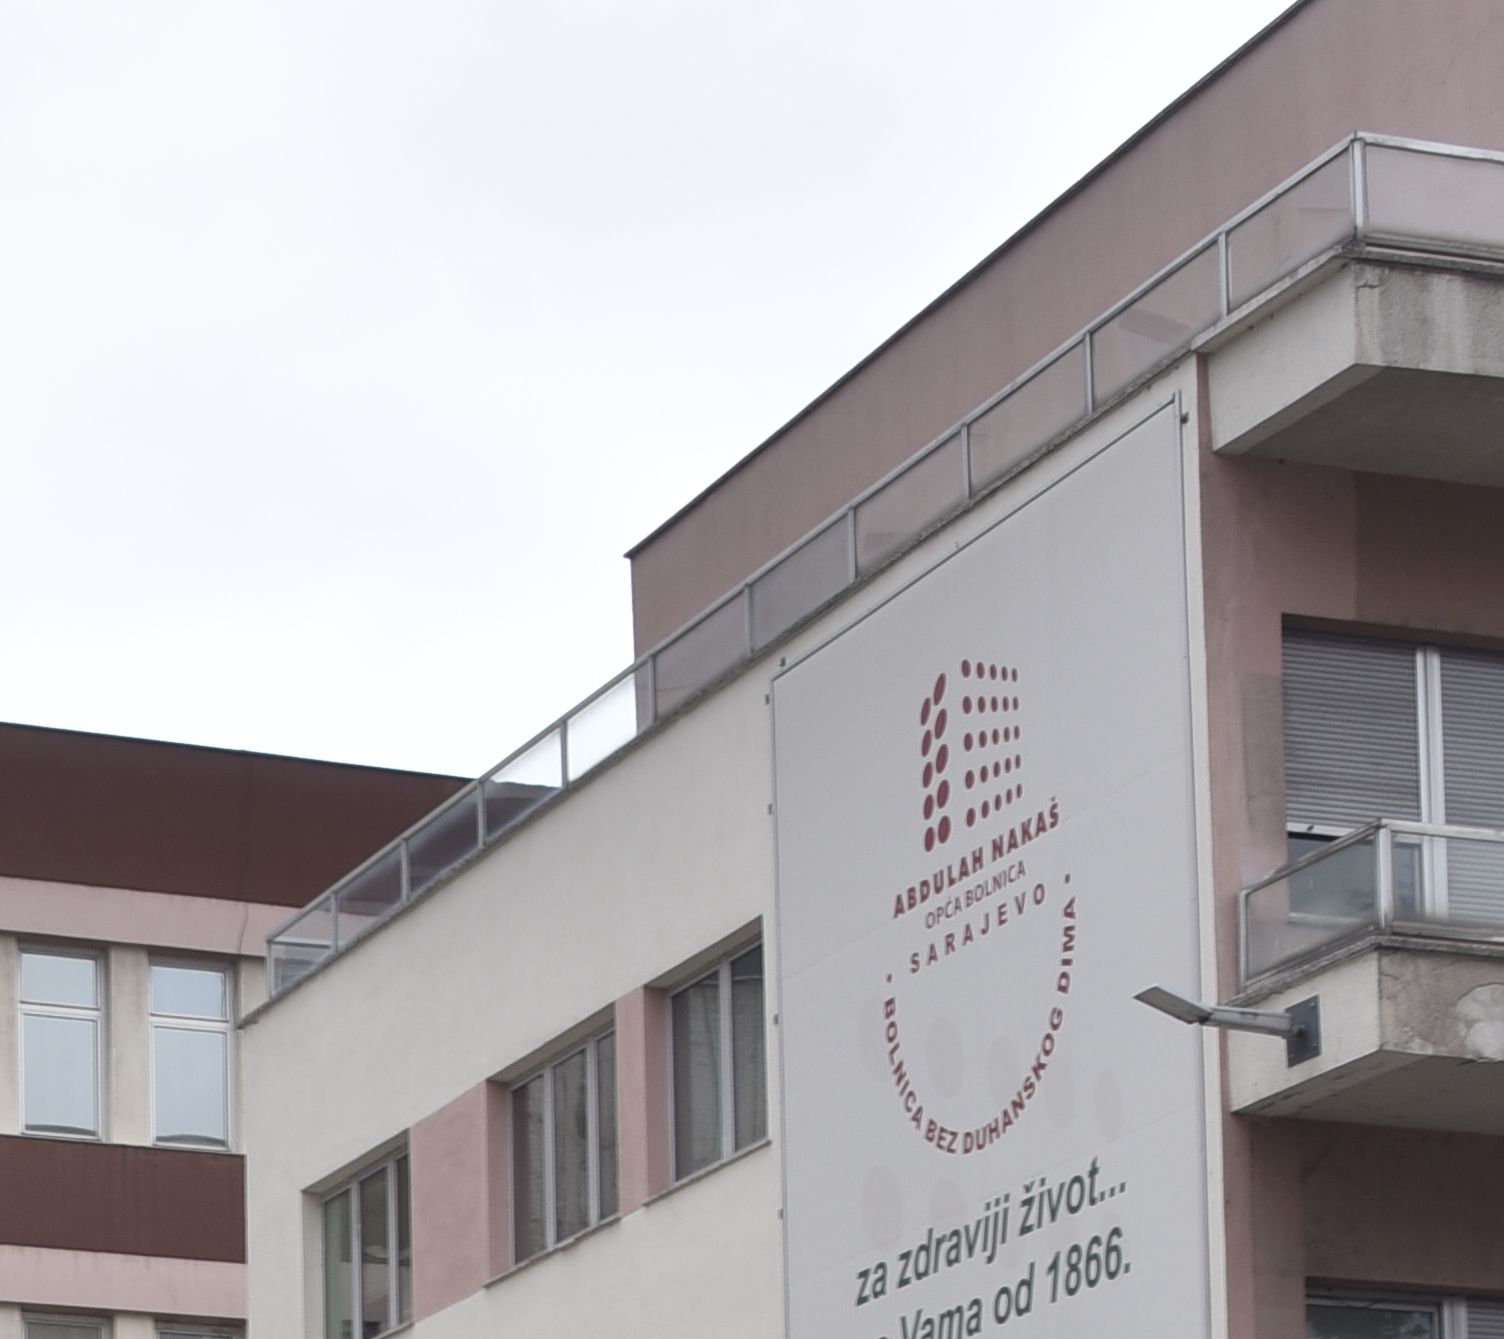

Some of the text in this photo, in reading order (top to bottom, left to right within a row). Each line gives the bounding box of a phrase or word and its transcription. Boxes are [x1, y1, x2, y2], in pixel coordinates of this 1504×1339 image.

[893, 796, 1060, 919] ABDULAH NAKAŠ
[925, 860, 1026, 930] OPĆA BOLNICA
[910, 882, 1045, 974] SARAJEVO
[884, 896, 1077, 1154] BOLNICA BEZ DUHANSKOG DIMA
[855, 1156, 1127, 1307] za zdraviji život...
[994, 1261, 1036, 1324] od
[1045, 1226, 1131, 1304] 1866.
